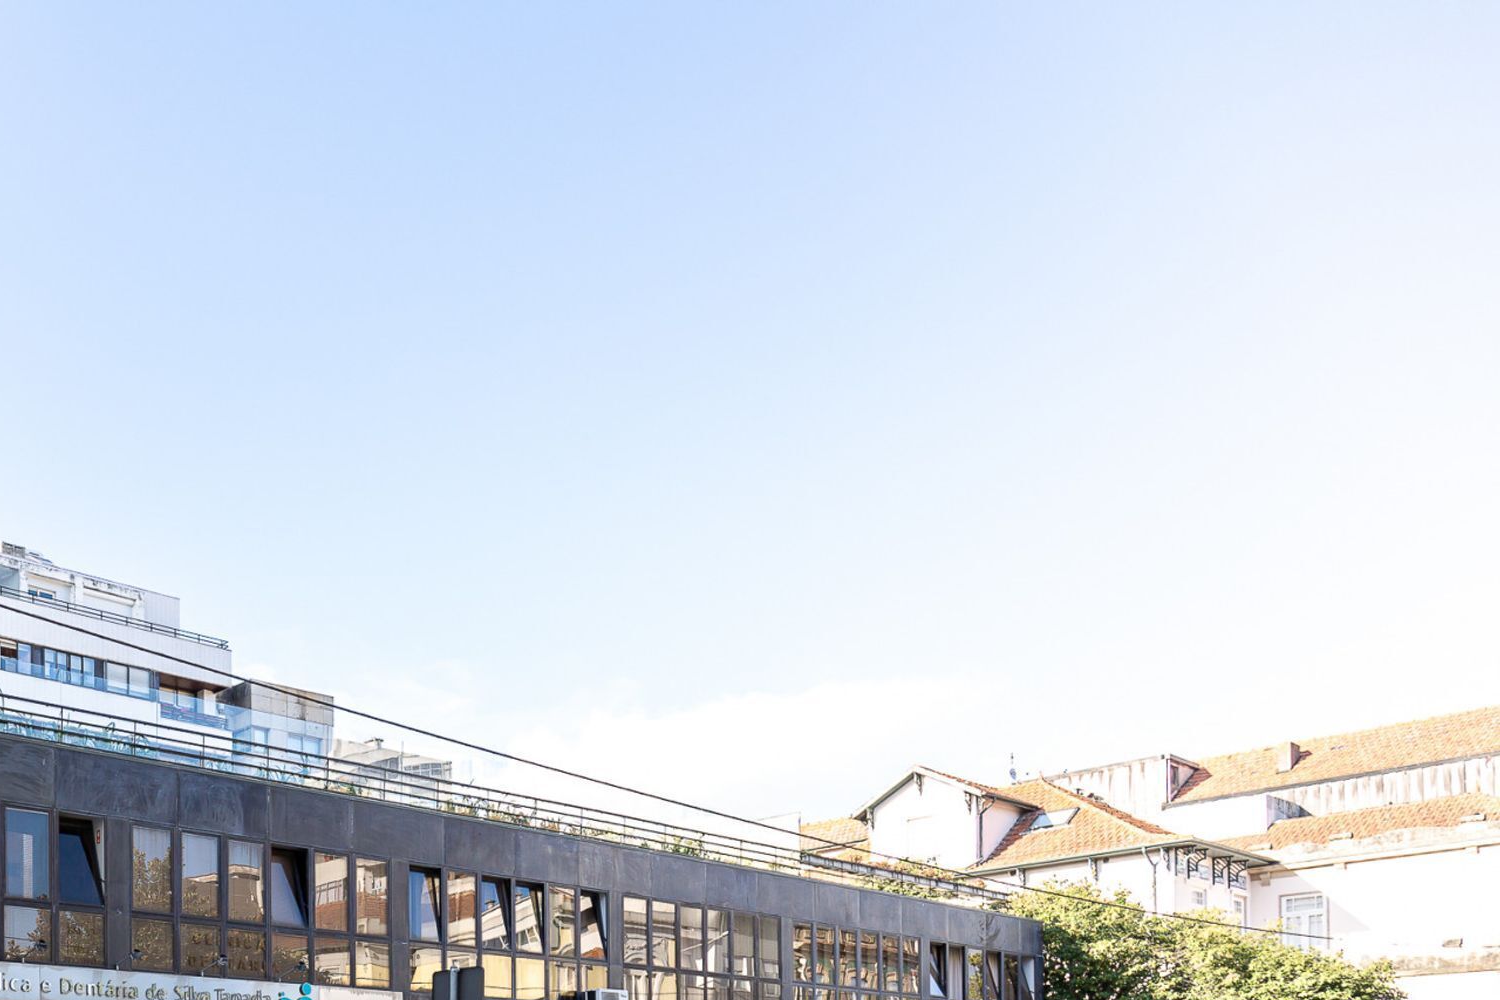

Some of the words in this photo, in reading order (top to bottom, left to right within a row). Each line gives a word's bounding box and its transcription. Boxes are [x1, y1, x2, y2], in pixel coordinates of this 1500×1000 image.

[39, 979, 52, 993] e
[59, 977, 139, 1000] Dentária
[145, 983, 167, 1000] de
